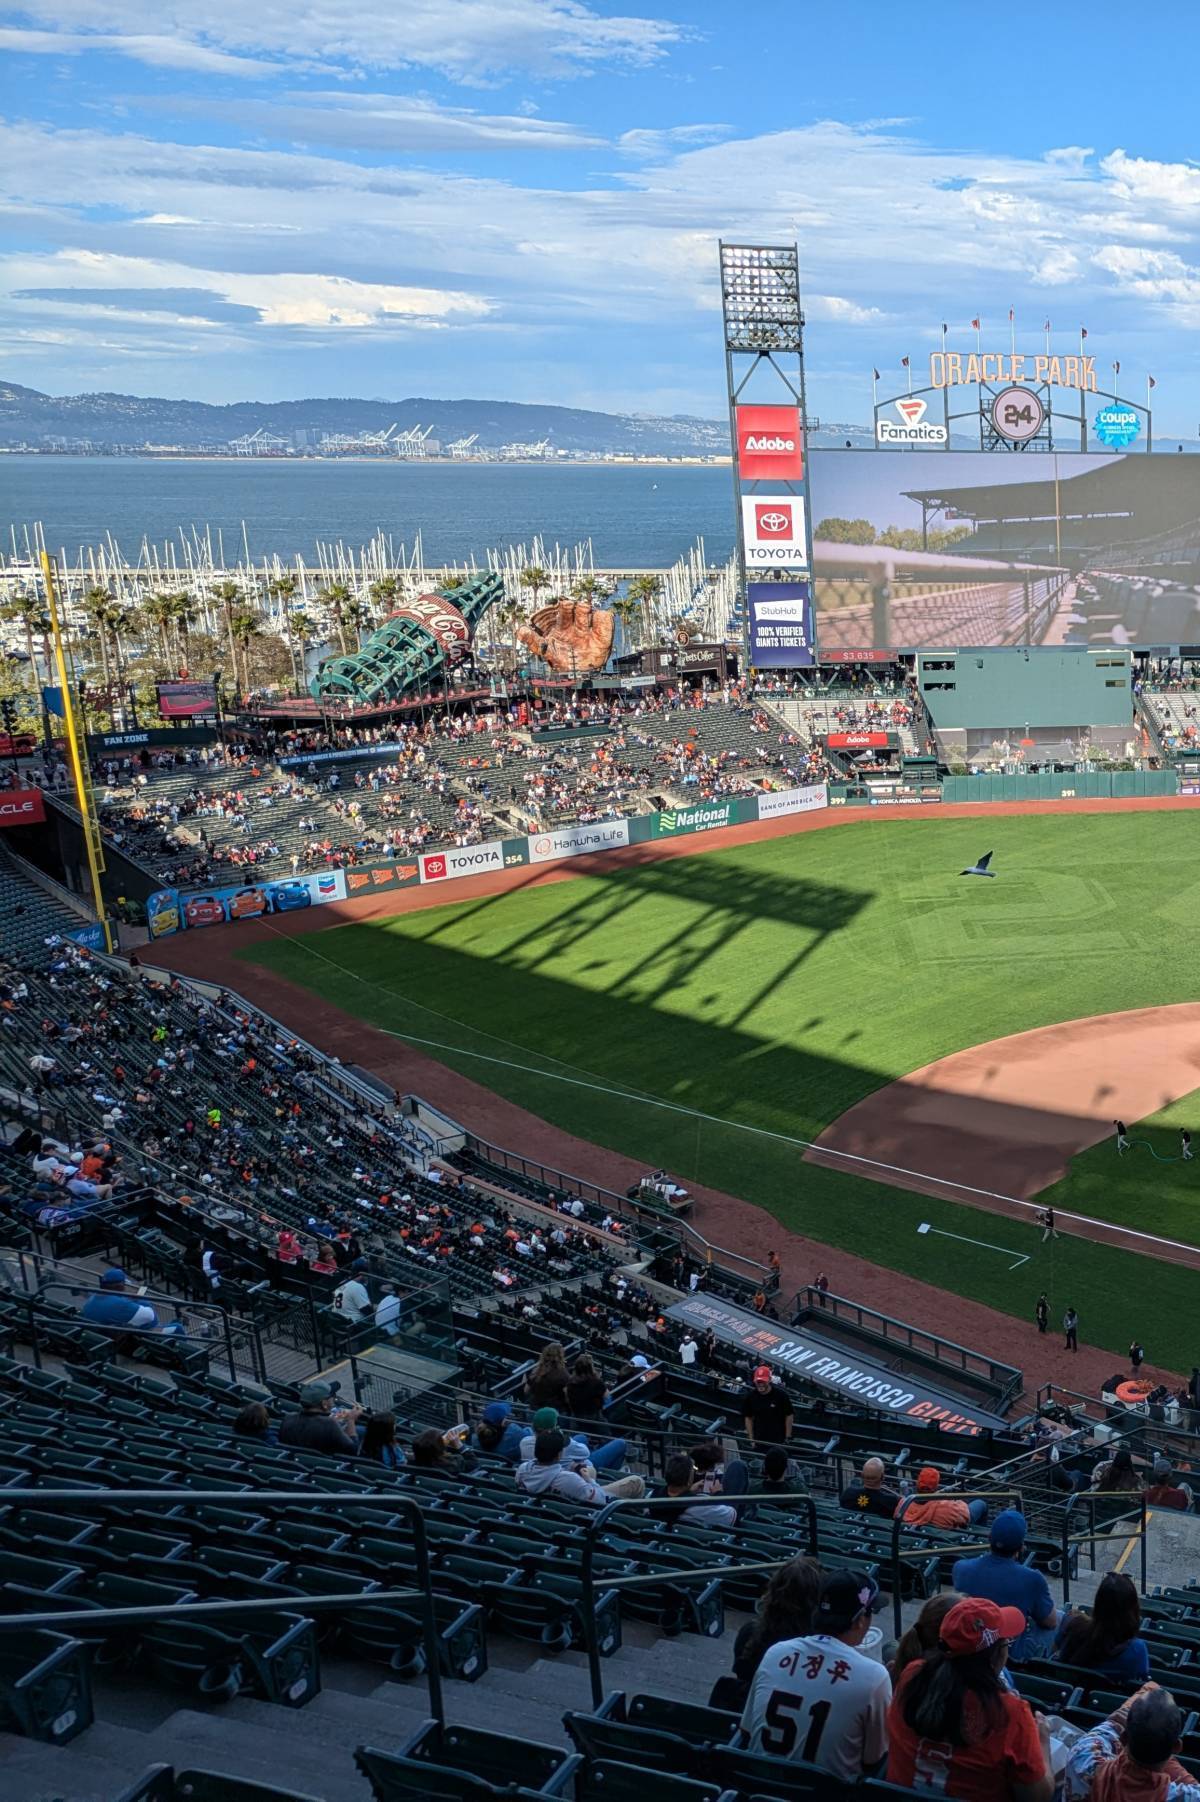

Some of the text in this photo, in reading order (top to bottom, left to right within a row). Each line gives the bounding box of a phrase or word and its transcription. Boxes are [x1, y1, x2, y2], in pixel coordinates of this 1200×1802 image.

[930, 352, 1097, 393] ORACLE PARK
[1004, 404, 1037, 426] 24
[1100, 412, 1136, 427] coupa
[881, 424, 944, 439] Fanatics
[745, 436, 795, 451] Adobe
[749, 548, 803, 559] TOYOTA
[761, 605, 797, 616] StubHub
[757, 626, 803, 636] 100% VERIFIED
[756, 637, 806, 648] GIANTS TICKETS
[104, 733, 149, 747] FAN ZONE
[1061, 789, 1076, 797] 391
[760, 803, 777, 811] BANK
[786, 797, 813, 807] AMERICA
[830, 797, 846, 805] 399
[677, 805, 730, 827] National
[695, 820, 728, 831] Car Rental
[554, 830, 623, 850] Hanwha Life
[450, 851, 500, 869] TOYOTA
[505, 854, 523, 865] 354
[770, 1341, 817, 1365] SAN
[805, 1356, 915, 1409] FRANCISCO
[779, 1652, 852, 1685] 이정후
[761, 1690, 832, 1763] 51
